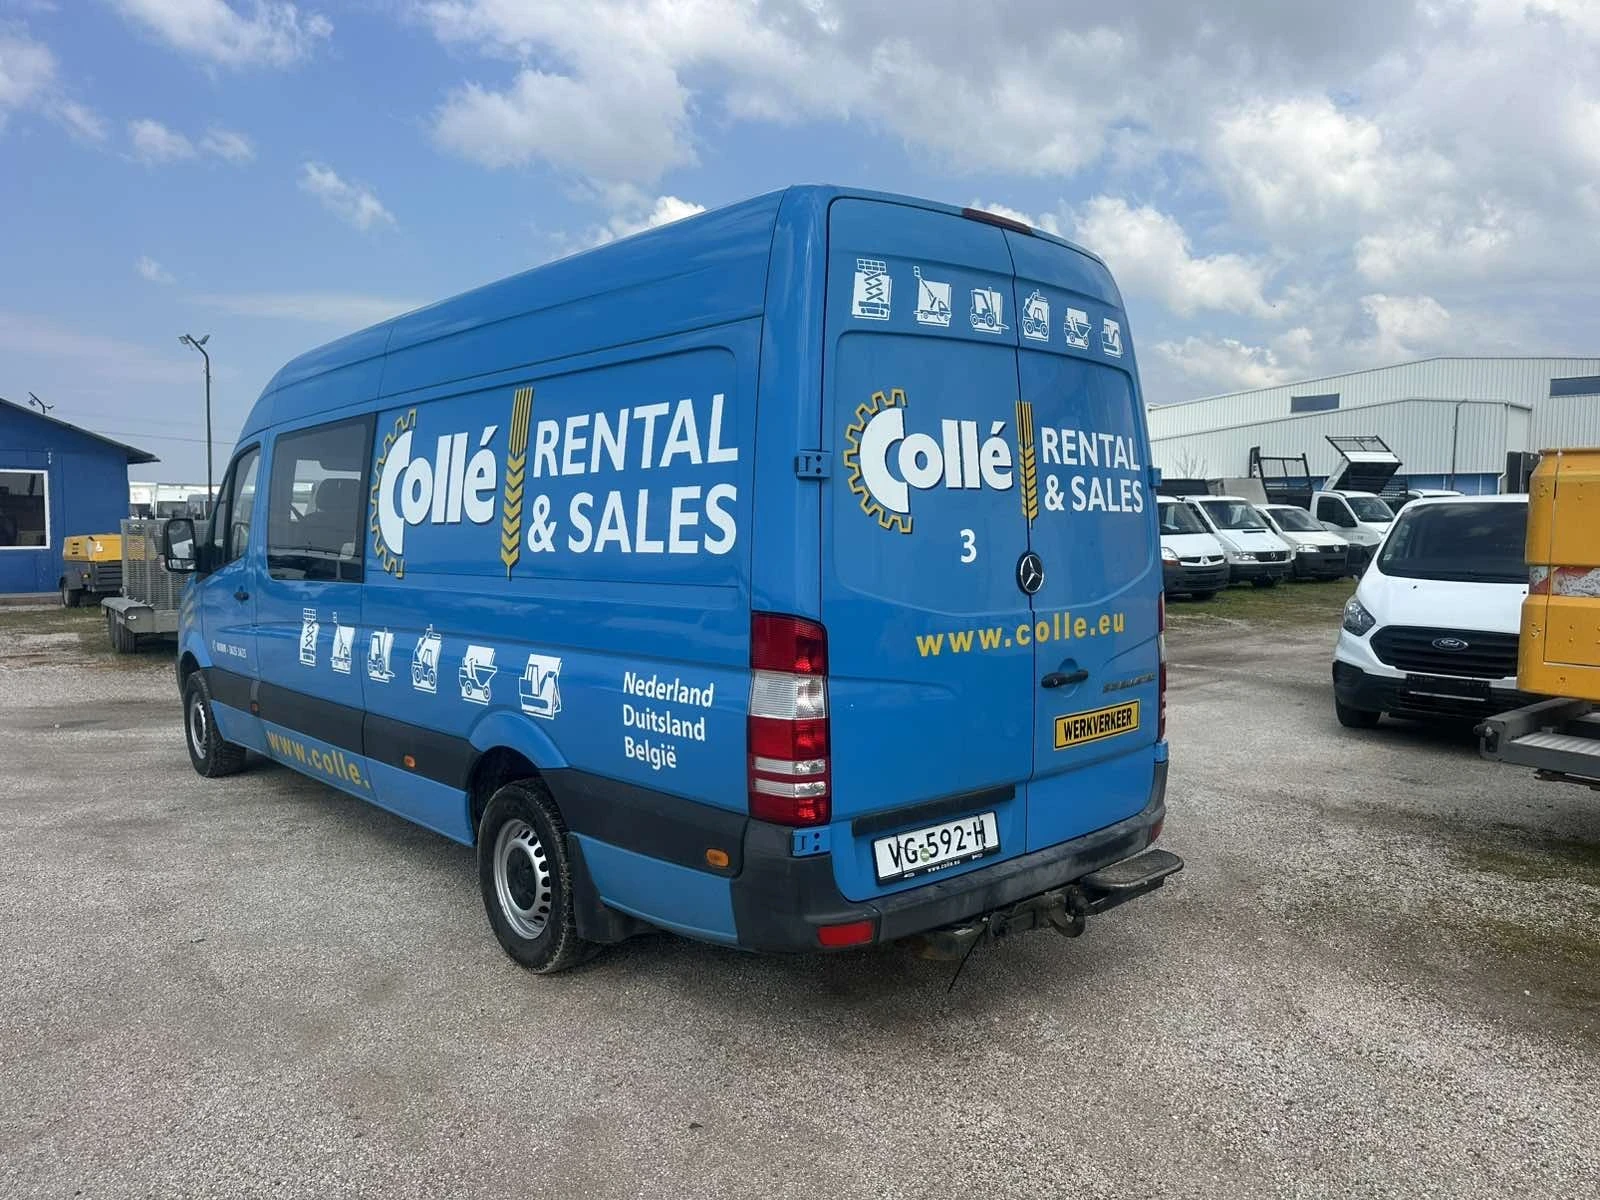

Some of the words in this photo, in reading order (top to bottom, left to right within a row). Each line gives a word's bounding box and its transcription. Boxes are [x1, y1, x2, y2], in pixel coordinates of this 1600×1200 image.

[532, 393, 739, 478] RENTAL
[1041, 426, 1141, 471] RENTAL
[859, 407, 1013, 513] Collé
[378, 425, 498, 555] Collé
[1044, 474, 1065, 512] &
[1071, 475, 1144, 514] SALES
[527, 494, 557, 553] &
[568, 483, 737, 555] SALES
[960, 528, 977, 563] 3
[916, 612, 1125, 657] www.colle.eu
[623, 671, 715, 708] Nederland
[622, 703, 706, 741] Duitsland
[1063, 707, 1133, 741] WERKVERKEER
[624, 736, 677, 771] België
[888, 819, 986, 869] VG-592-H
